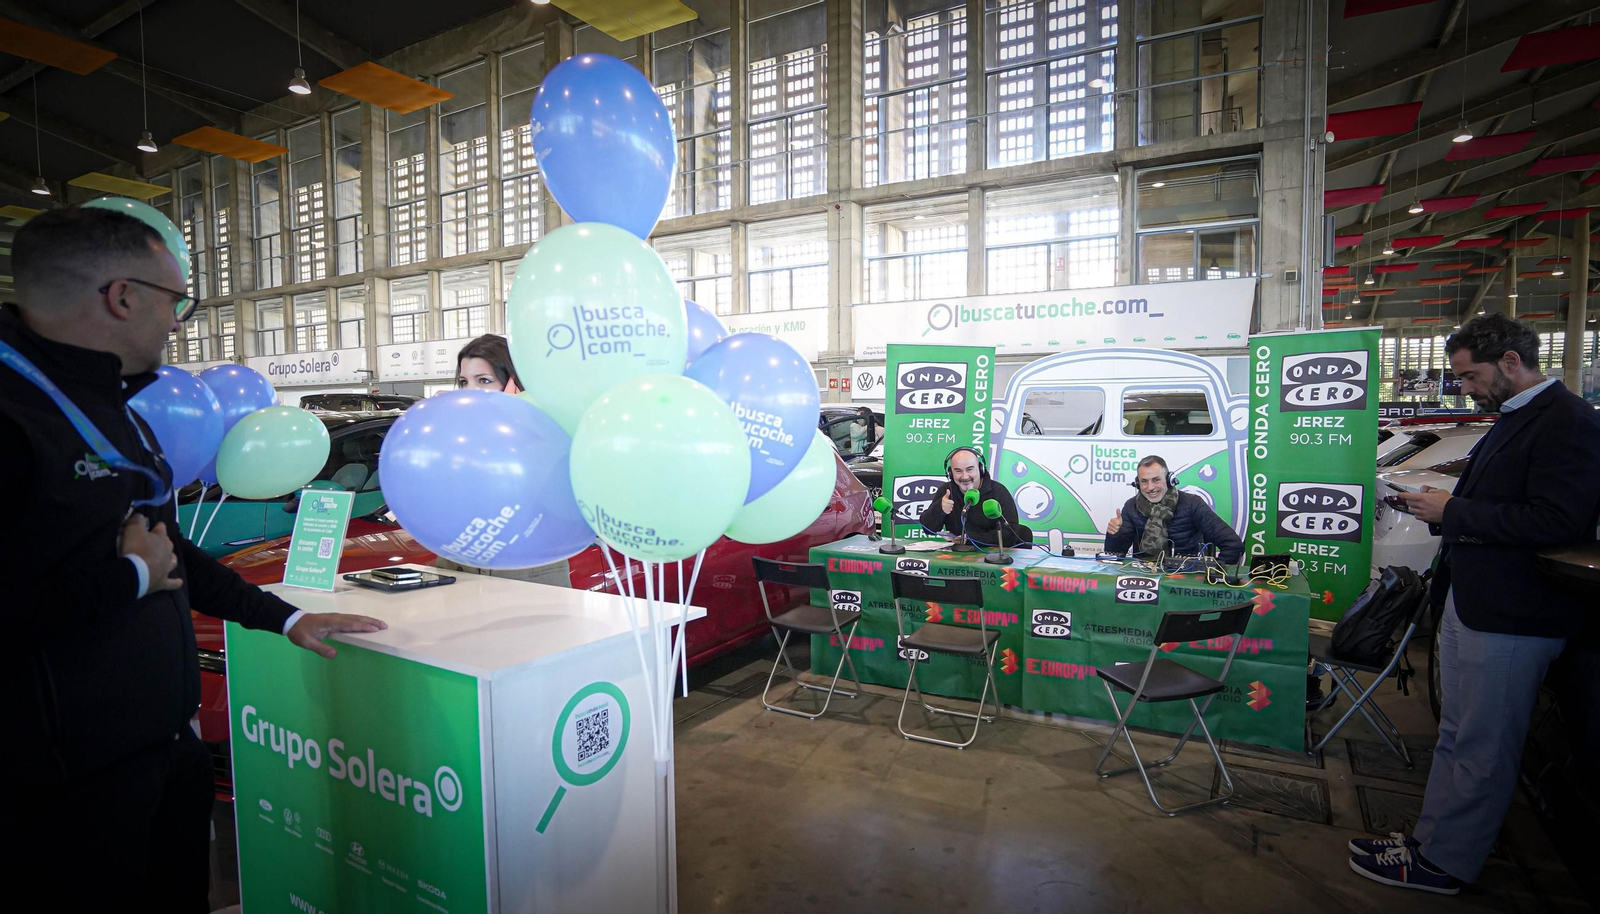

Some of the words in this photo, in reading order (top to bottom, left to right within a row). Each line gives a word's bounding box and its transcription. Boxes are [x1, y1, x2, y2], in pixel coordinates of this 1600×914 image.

[580, 304, 644, 322] busca
[584, 319, 670, 339] tucoche.
[775, 326, 780, 335] y
[268, 361, 298, 377] Grupo
[299, 358, 331, 375] Solera
[1255, 345, 1271, 398] CERO
[1292, 364, 1354, 378] ONDA
[906, 372, 956, 383] ONDA
[974, 354, 989, 402] CERO
[908, 392, 956, 405] CERO
[1295, 387, 1354, 401] CERO
[735, 402, 783, 428] busca
[1292, 416, 1345, 428] JEREZ
[908, 418, 951, 428] JEREZ
[905, 432, 933, 444] 90.3
[937, 433, 956, 444] FM
[972, 407, 986, 457] ONDA
[1254, 403, 1269, 459] ONDA
[1289, 433, 1323, 445] 90.3
[1328, 433, 1352, 445] FM
[1095, 444, 1137, 458] busca
[1095, 458, 1138, 471] tucoc
[902, 485, 938, 495] OND
[1252, 473, 1268, 524] CERO
[1289, 494, 1350, 507] ONDA
[904, 504, 925, 516] CE
[601, 508, 656, 537] busca
[1291, 515, 1349, 531] CERO
[444, 517, 487, 553] busca
[461, 504, 520, 558] tucoche.
[602, 522, 684, 546] tucoche.
[904, 529, 938, 538] JER
[1251, 530, 1266, 556] DA
[1289, 542, 1340, 558] JEREZ
[840, 558, 874, 575] EUROPA
[937, 567, 997, 580] ATRESMEDIA
[1296, 559, 1319, 572] 0.3
[1323, 562, 1347, 575] FM
[1042, 575, 1086, 593] EUROPA
[1121, 579, 1154, 587] ONDA
[1122, 591, 1153, 600] CERO
[1169, 587, 1246, 601] ATRESMEDIA
[867, 600, 922, 613] ATRESEDIA
[1037, 614, 1066, 623] ONDA
[1038, 627, 1066, 635] CERO
[1084, 623, 1154, 638] ATRESMEDIA
[1122, 637, 1153, 646] RADIO
[1041, 660, 1085, 680] EUROPA
[1216, 695, 1242, 703] ADIO
[241, 704, 322, 769] Grupo
[328, 737, 433, 818] Solera
